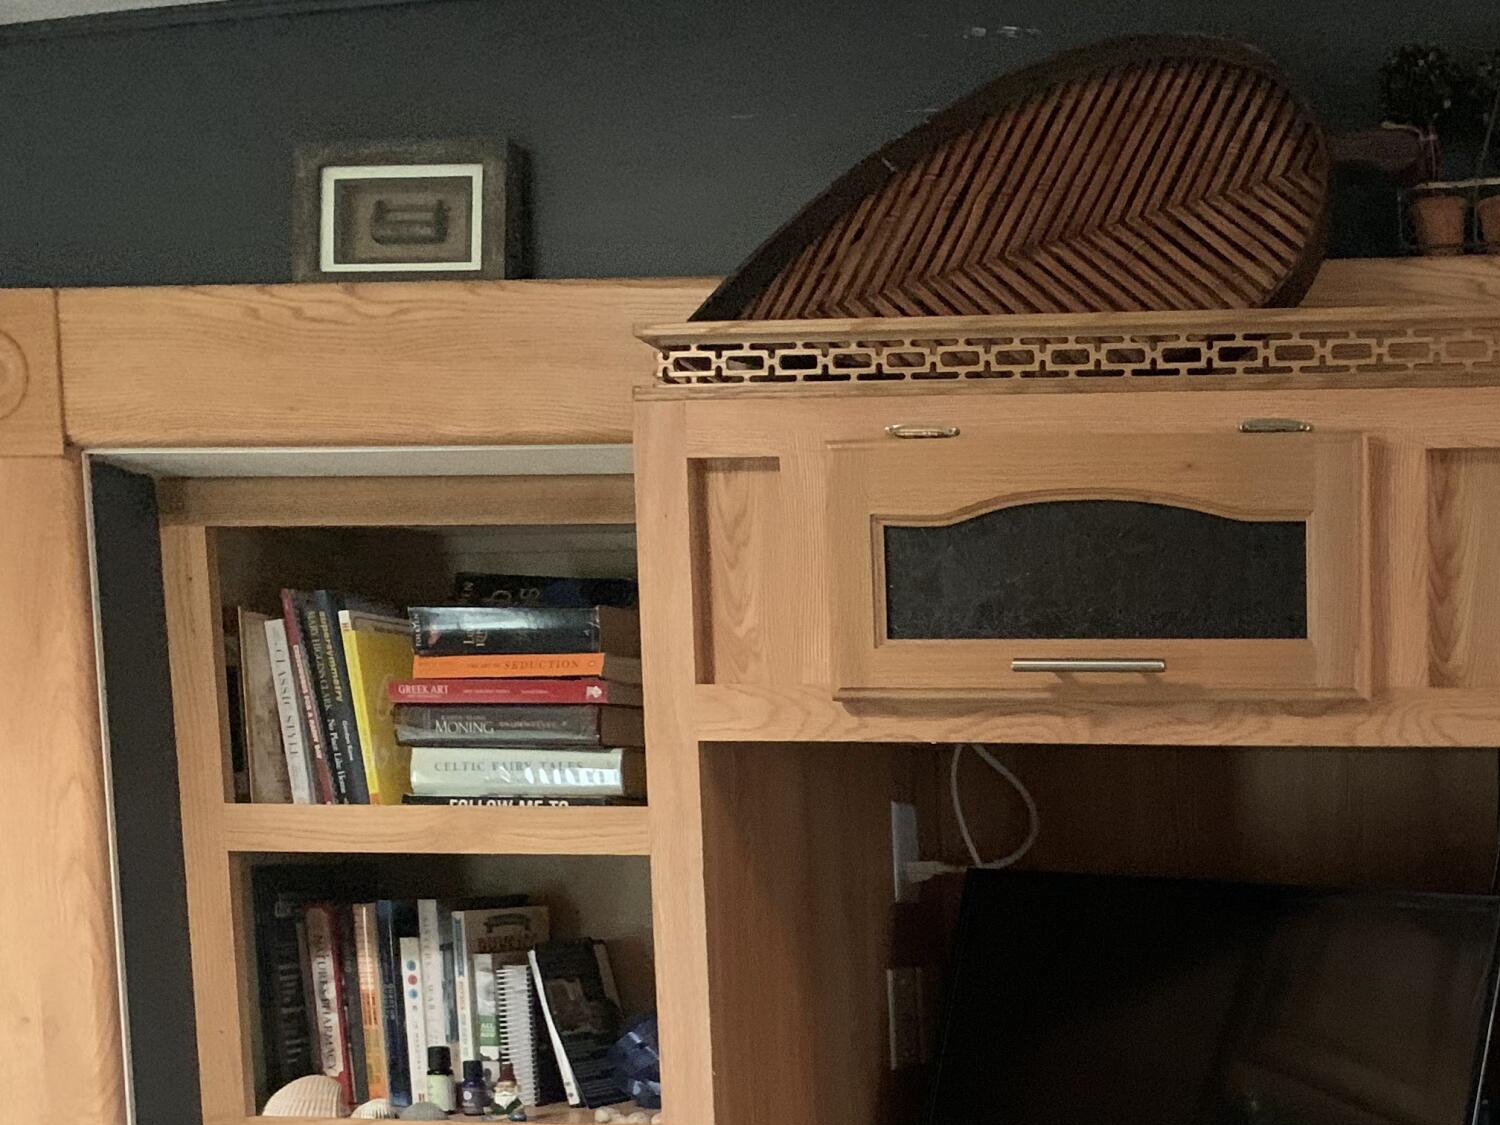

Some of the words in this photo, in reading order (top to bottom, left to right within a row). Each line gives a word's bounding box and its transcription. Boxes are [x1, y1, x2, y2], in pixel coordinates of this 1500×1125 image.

[504, 658, 580, 670] SEDUCTION
[398, 683, 429, 696] GREEK
[429, 683, 449, 695] ART
[434, 719, 495, 735] MONING
[434, 760, 486, 773] CELTIC
[491, 760, 532, 773] FAIRY
[539, 760, 584, 772] TALES
